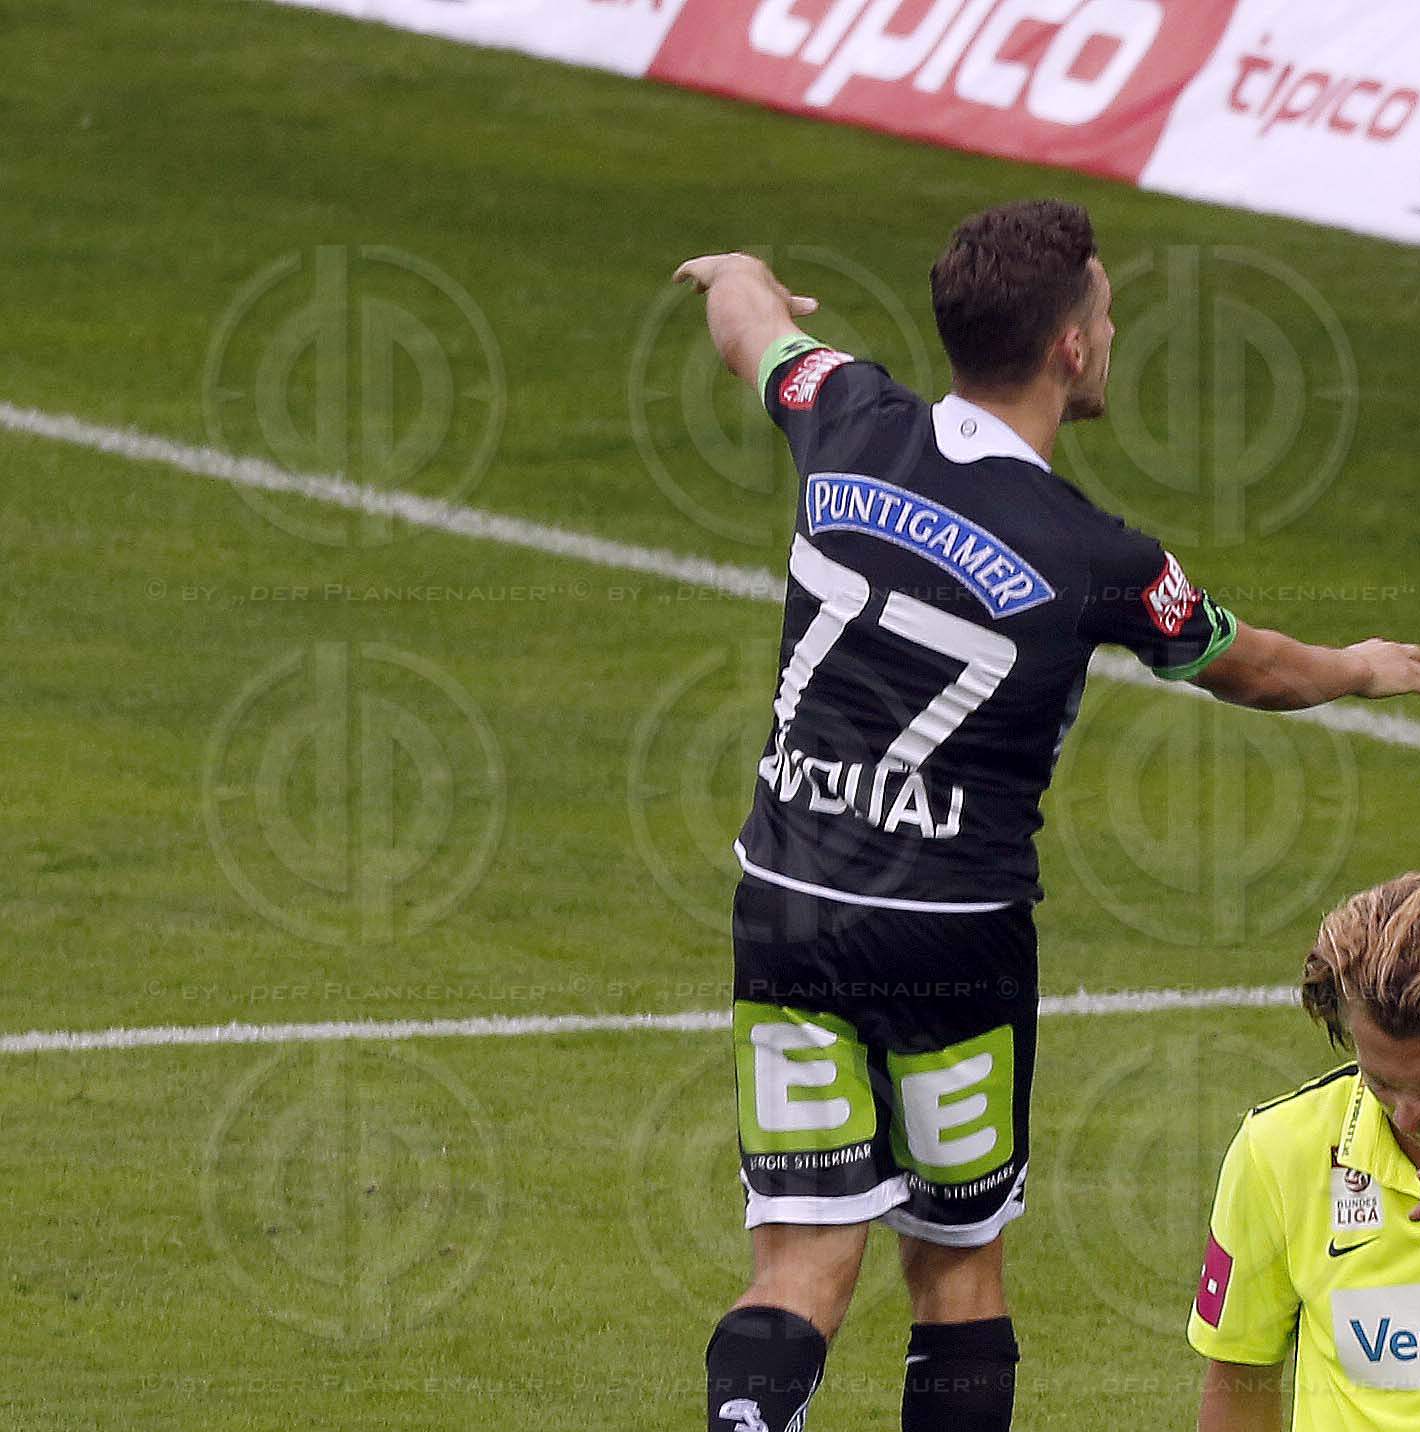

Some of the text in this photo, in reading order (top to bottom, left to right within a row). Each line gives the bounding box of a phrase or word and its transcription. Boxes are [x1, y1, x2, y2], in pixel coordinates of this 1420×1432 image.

[1228, 33, 1419, 139] tipico
[814, 479, 1035, 607] PUNTIGAMER
[774, 533, 1018, 772] 77
[751, 1022, 851, 1132] E
[902, 1052, 997, 1168] E
[794, 1143, 872, 1171] STEIERMAR
[1337, 1196, 1377, 1209] BUNDES
[1336, 1208, 1380, 1225] LIGA
